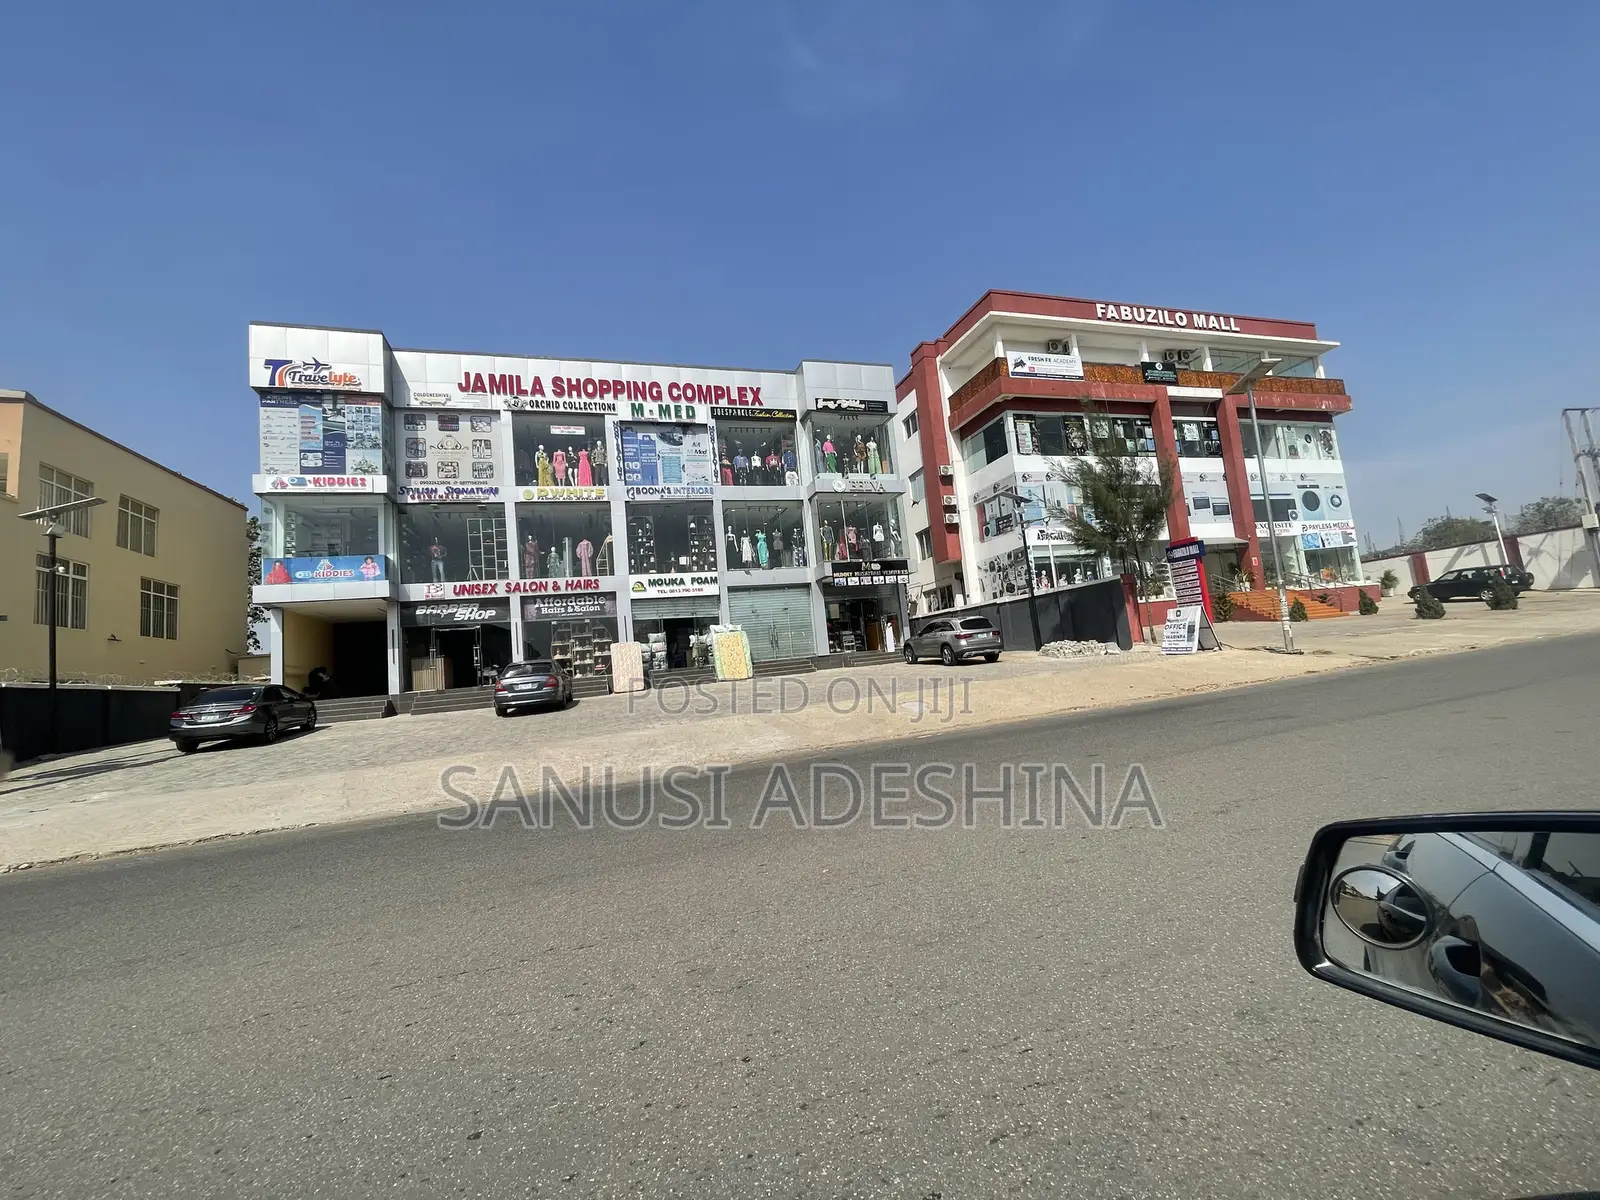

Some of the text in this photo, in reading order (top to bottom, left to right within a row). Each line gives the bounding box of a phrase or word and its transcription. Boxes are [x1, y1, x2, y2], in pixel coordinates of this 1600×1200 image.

[1095, 303, 1241, 332] FABUZILO MALL
[457, 371, 764, 406] JAMILA SHOPPING COMPLEX
[529, 400, 616, 412] ORCHID COLLECTIONS
[312, 476, 367, 488] KIDDIES
[635, 486, 672, 495] BOONA'S
[313, 569, 354, 578] KIDDIES
[452, 583, 498, 596] UNISEX
[505, 580, 549, 595] SALON
[551, 581, 561, 592] &
[565, 579, 600, 591] HAIRS
[647, 576, 718, 588] MOUKA FOAM
[534, 595, 606, 608] Affordable
[453, 608, 497, 621] SHOP
[541, 607, 565, 615] Hairs
[567, 605, 574, 613] &
[574, 604, 601, 612] Salon
